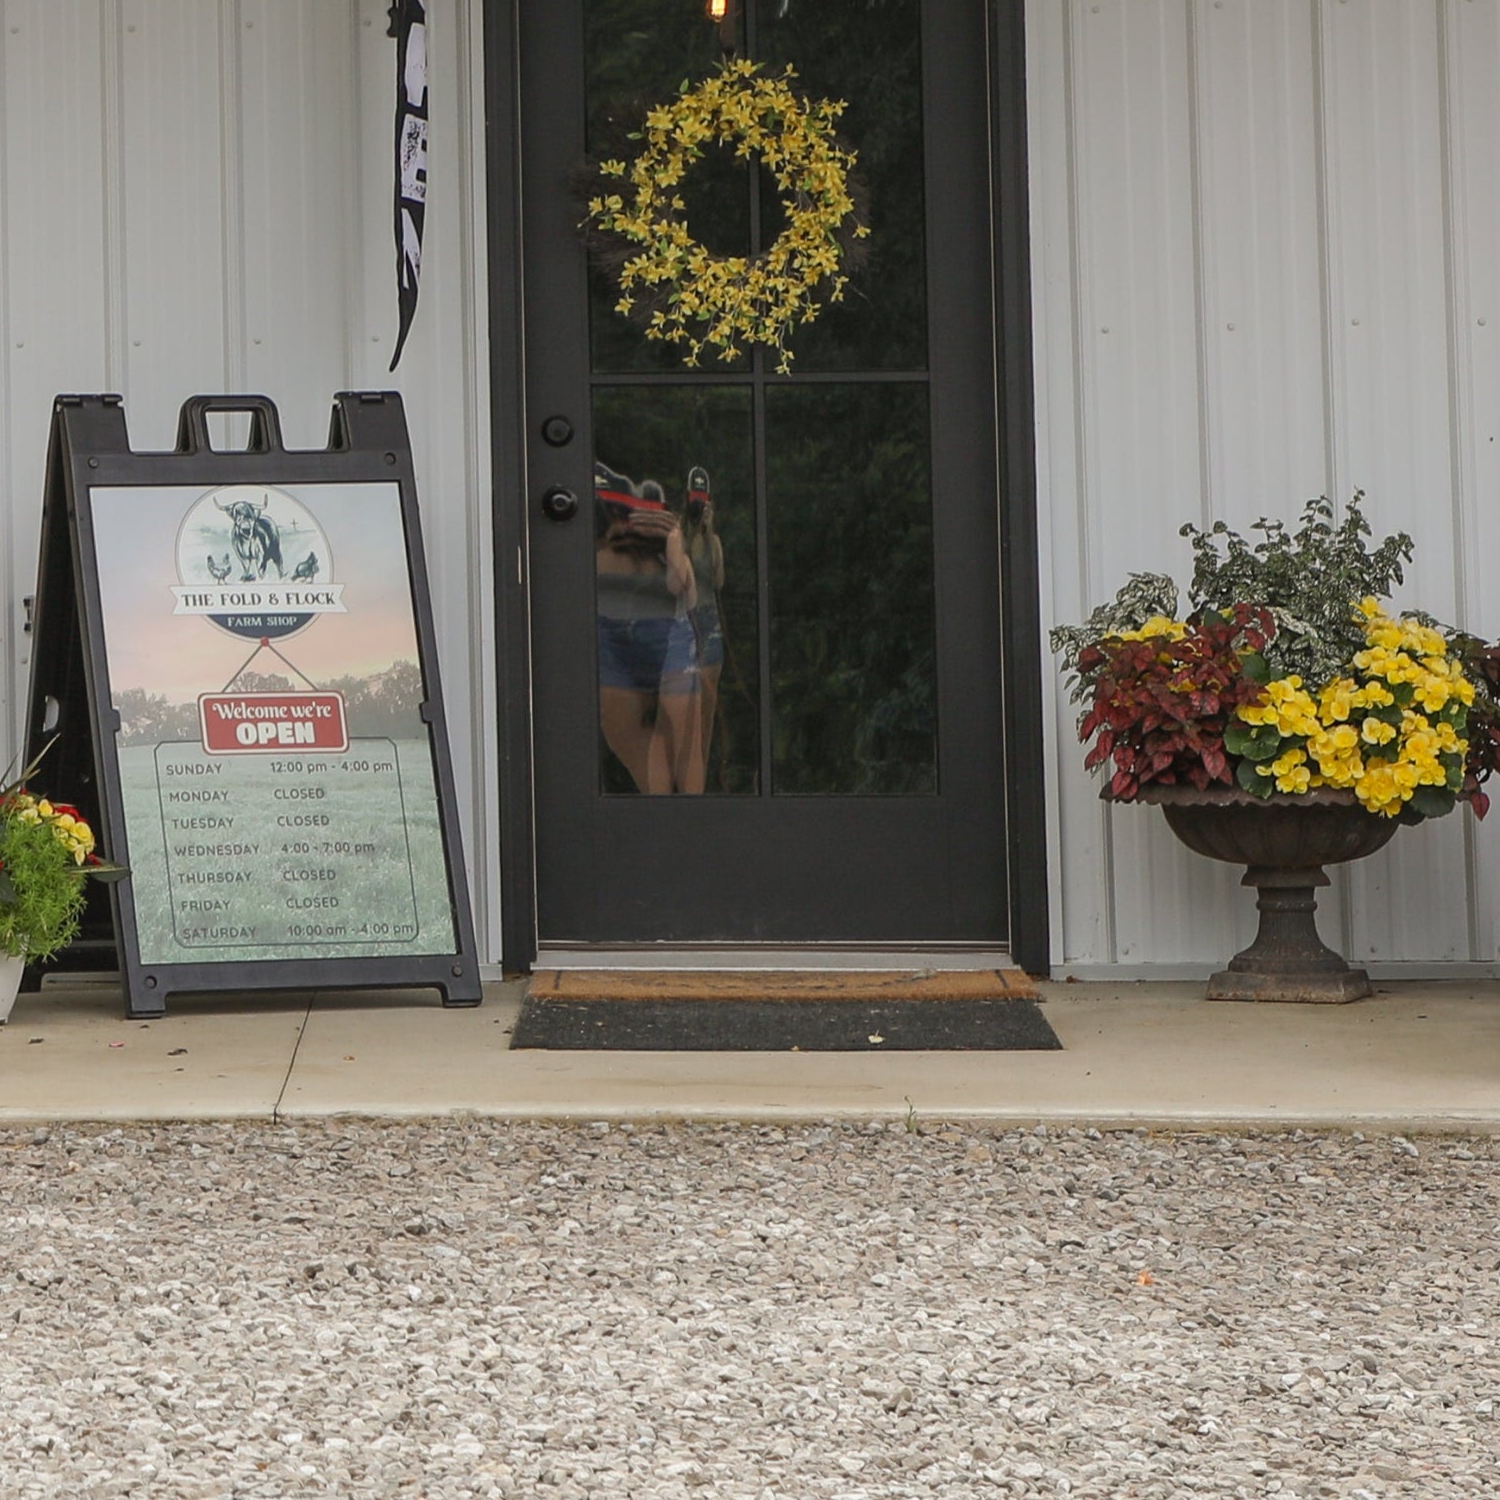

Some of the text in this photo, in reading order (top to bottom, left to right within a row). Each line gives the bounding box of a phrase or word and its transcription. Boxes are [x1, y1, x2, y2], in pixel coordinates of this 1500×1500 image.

[181, 592, 335, 607] THE FOLD & FLOCK
[227, 616, 298, 627] FARM SHOP
[212, 701, 332, 719] Welcome we're
[236, 721, 315, 745] OPEN
[166, 764, 222, 775] SUNDAY
[270, 761, 303, 773] 12:00
[307, 763, 327, 774] pm
[341, 761, 369, 771] 4:00
[373, 762, 393, 773] pm
[169, 788, 325, 802] MONDAY CLOSED
[172, 815, 330, 829] TUESDAY CLOSED
[174, 844, 260, 856] WEDNESDAY
[281, 842, 310, 854] 4:00
[322, 842, 350, 853] 7:00
[355, 843, 375, 854] pm
[178, 869, 336, 884] THURSDAY CLOSED
[181, 897, 339, 911] FRIDAY CLOSED
[183, 927, 256, 940] SATURDAY
[288, 925, 322, 936] 10:00
[327, 926, 347, 936] am
[361, 923, 389, 934] 4:00
[393, 924, 414, 935] pm
